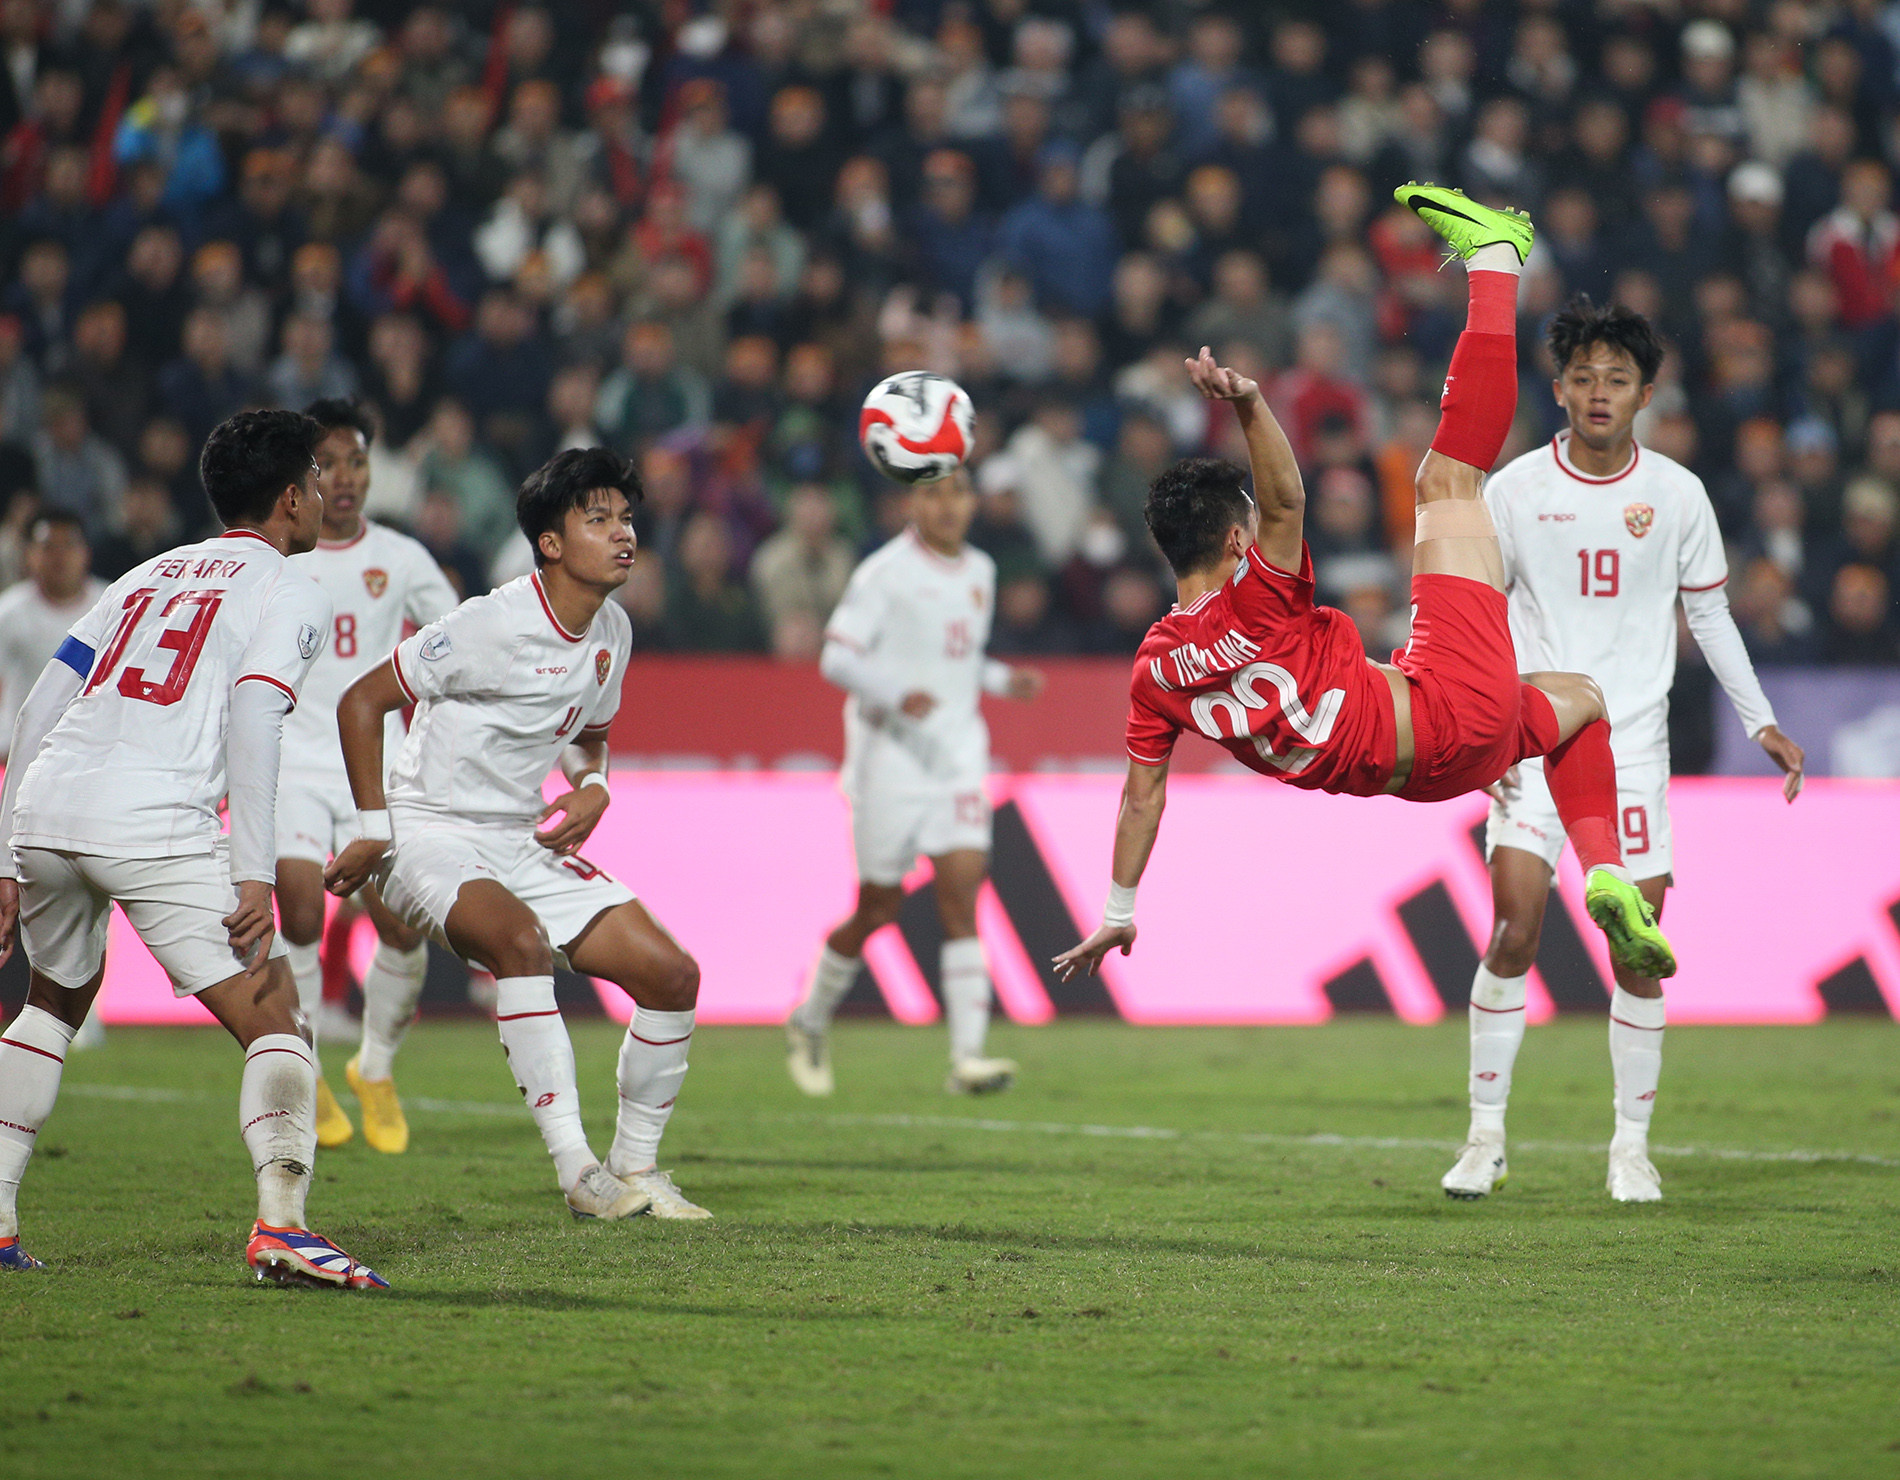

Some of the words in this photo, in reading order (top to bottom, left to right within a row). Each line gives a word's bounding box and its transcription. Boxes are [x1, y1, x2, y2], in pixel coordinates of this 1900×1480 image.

[148, 558, 247, 579] FERARRI
[1577, 548, 1620, 598] 19
[82, 587, 228, 707] 13
[334, 613, 357, 659] 8
[535, 665, 568, 676] erspo
[551, 705, 584, 745] 4
[1190, 660, 1347, 776] 22
[1622, 805, 1650, 855] 9
